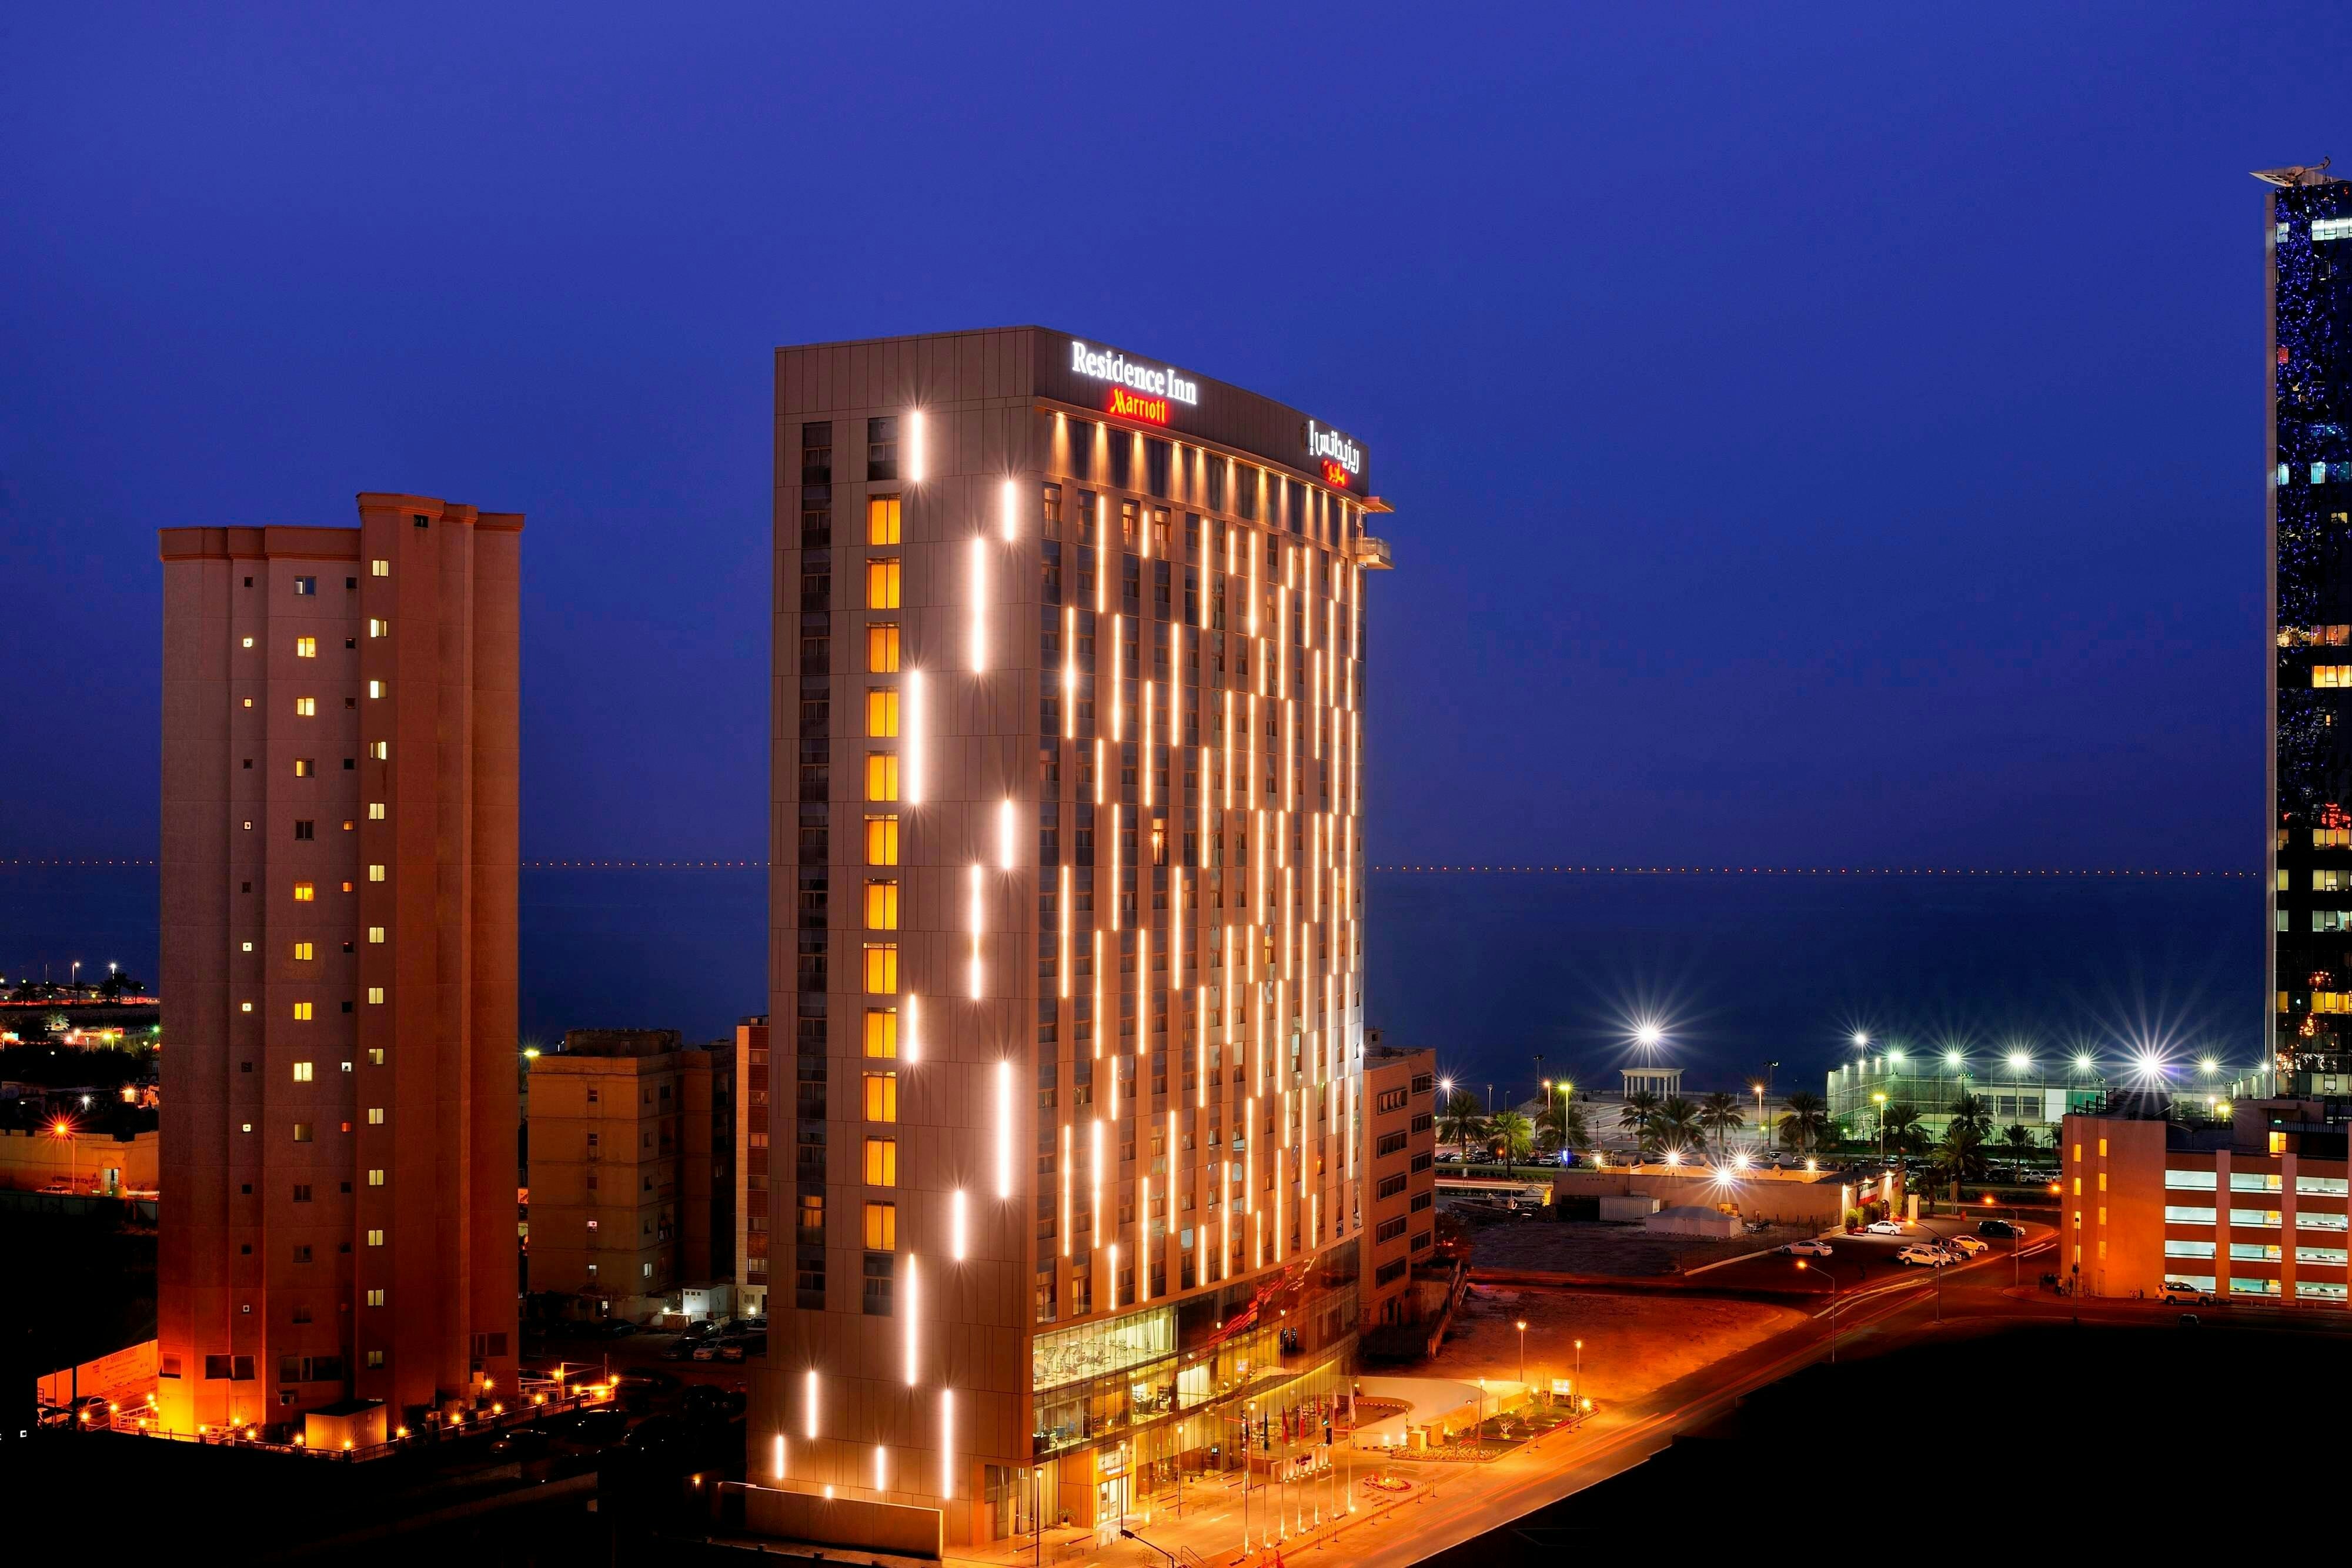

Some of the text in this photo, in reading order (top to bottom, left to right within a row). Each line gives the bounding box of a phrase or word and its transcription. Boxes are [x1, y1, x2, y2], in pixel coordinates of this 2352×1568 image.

[1072, 341, 1197, 405] Residence Inn
[1110, 388, 1166, 422] Marriott
[1314, 430, 1359, 474] ريزيدانس
[125, 1348, 137, 1359] FIRST
